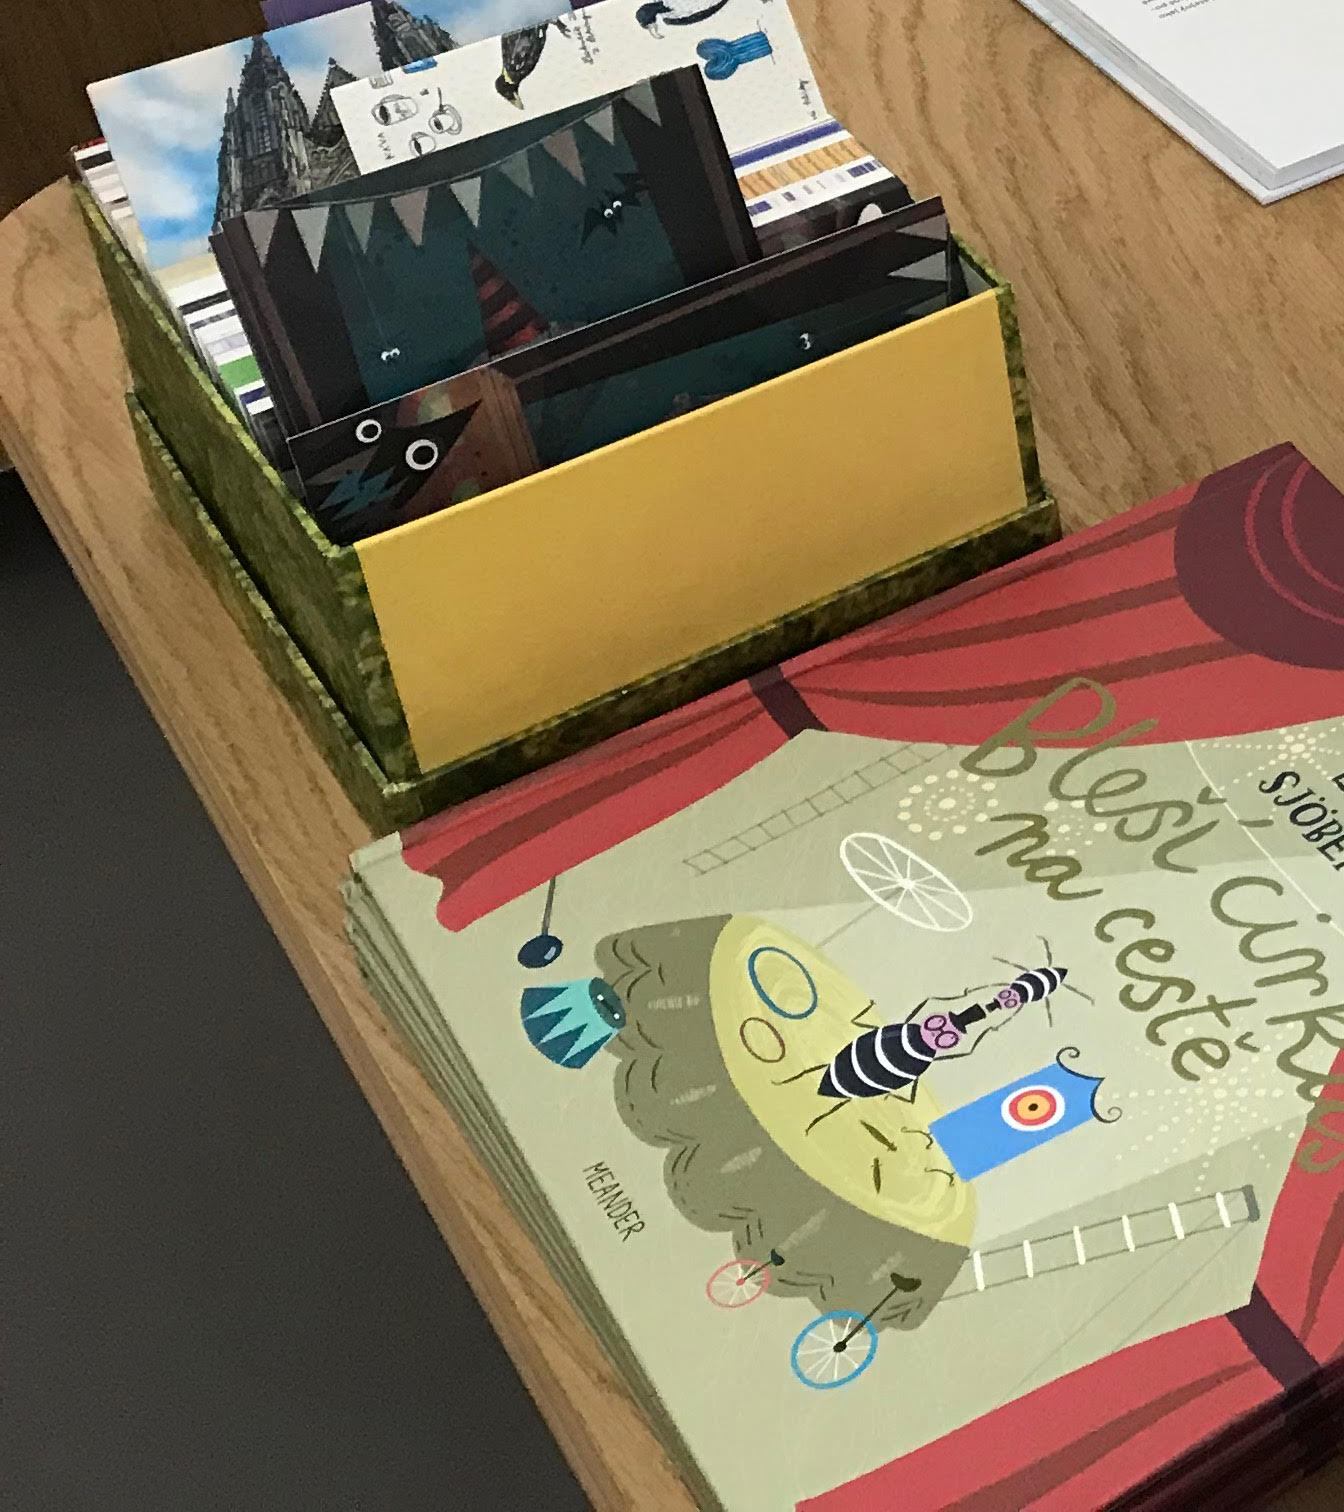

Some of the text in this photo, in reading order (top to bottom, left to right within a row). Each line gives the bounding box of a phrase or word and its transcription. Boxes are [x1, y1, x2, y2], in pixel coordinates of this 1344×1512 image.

[959, 677, 1274, 874] Bleší
[974, 813, 1262, 1083] na cestě
[582, 1160, 646, 1242] MEANDER
